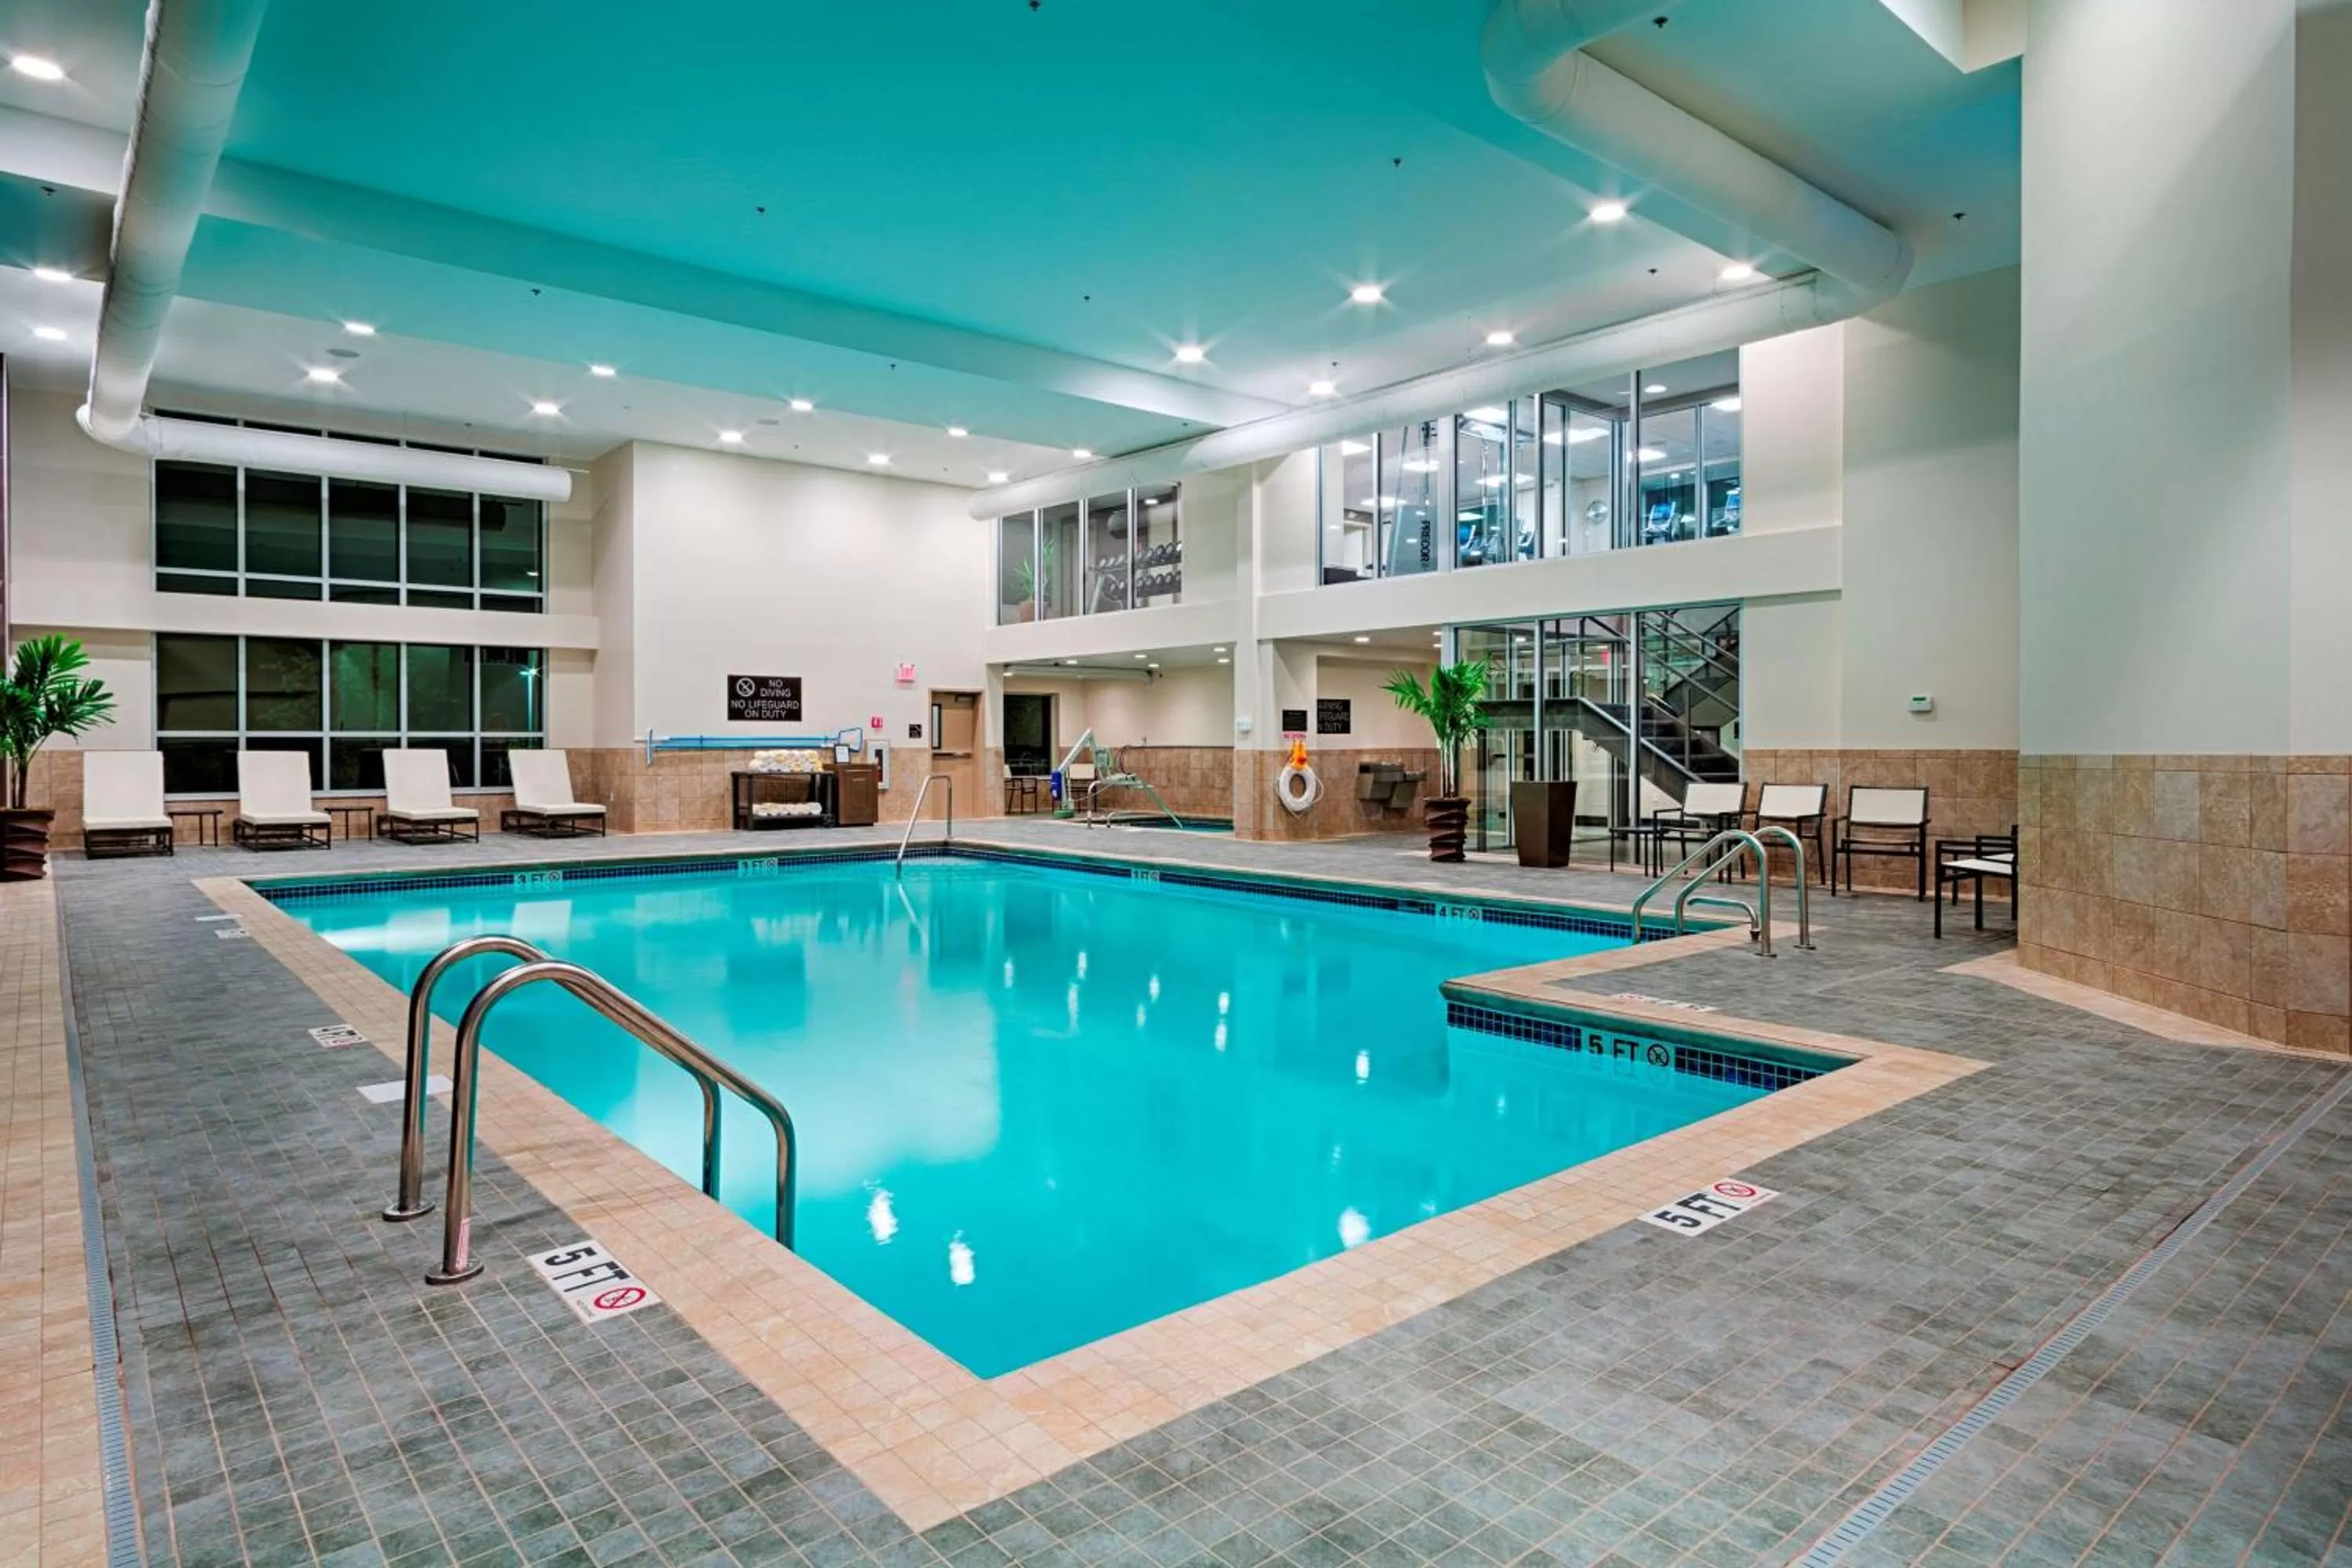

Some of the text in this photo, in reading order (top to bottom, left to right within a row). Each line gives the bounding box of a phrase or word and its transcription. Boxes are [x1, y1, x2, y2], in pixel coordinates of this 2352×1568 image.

[769, 679, 783, 688] NO
[760, 688, 791, 697] DIVING
[731, 699, 800, 710] NO LIFEGUARD
[744, 710, 786, 719] ON DUTY
[531, 873, 546, 883] FT
[1439, 906, 1465, 919] 4 FT
[1588, 1033, 1639, 1062] 5 FT
[1675, 1192, 1741, 1219] FT
[1653, 1210, 1702, 1228] 5
[544, 1246, 631, 1293] 5 FT
